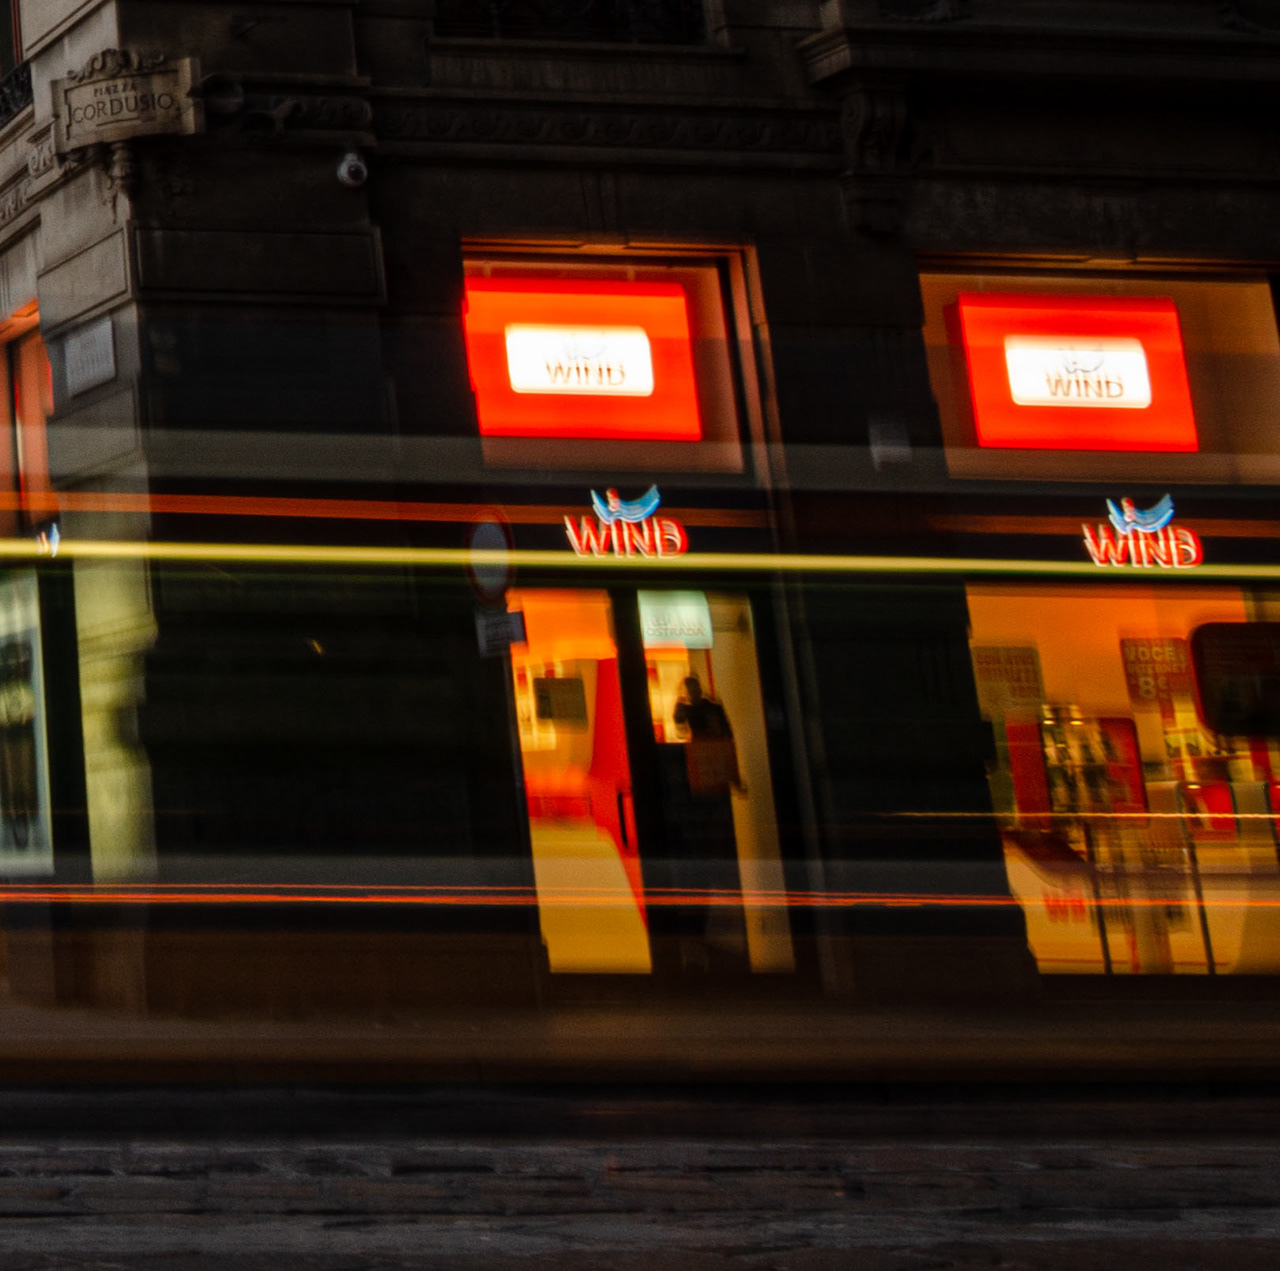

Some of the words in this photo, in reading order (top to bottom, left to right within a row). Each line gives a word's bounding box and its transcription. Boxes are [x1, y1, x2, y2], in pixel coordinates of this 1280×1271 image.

[94, 81, 137, 97] PIAZZA
[73, 93, 174, 124] CORDUSIO
[544, 357, 626, 386] WIND
[1046, 371, 1124, 399] WIND
[564, 515, 688, 559] WIND
[1082, 523, 1204, 569] WIND
